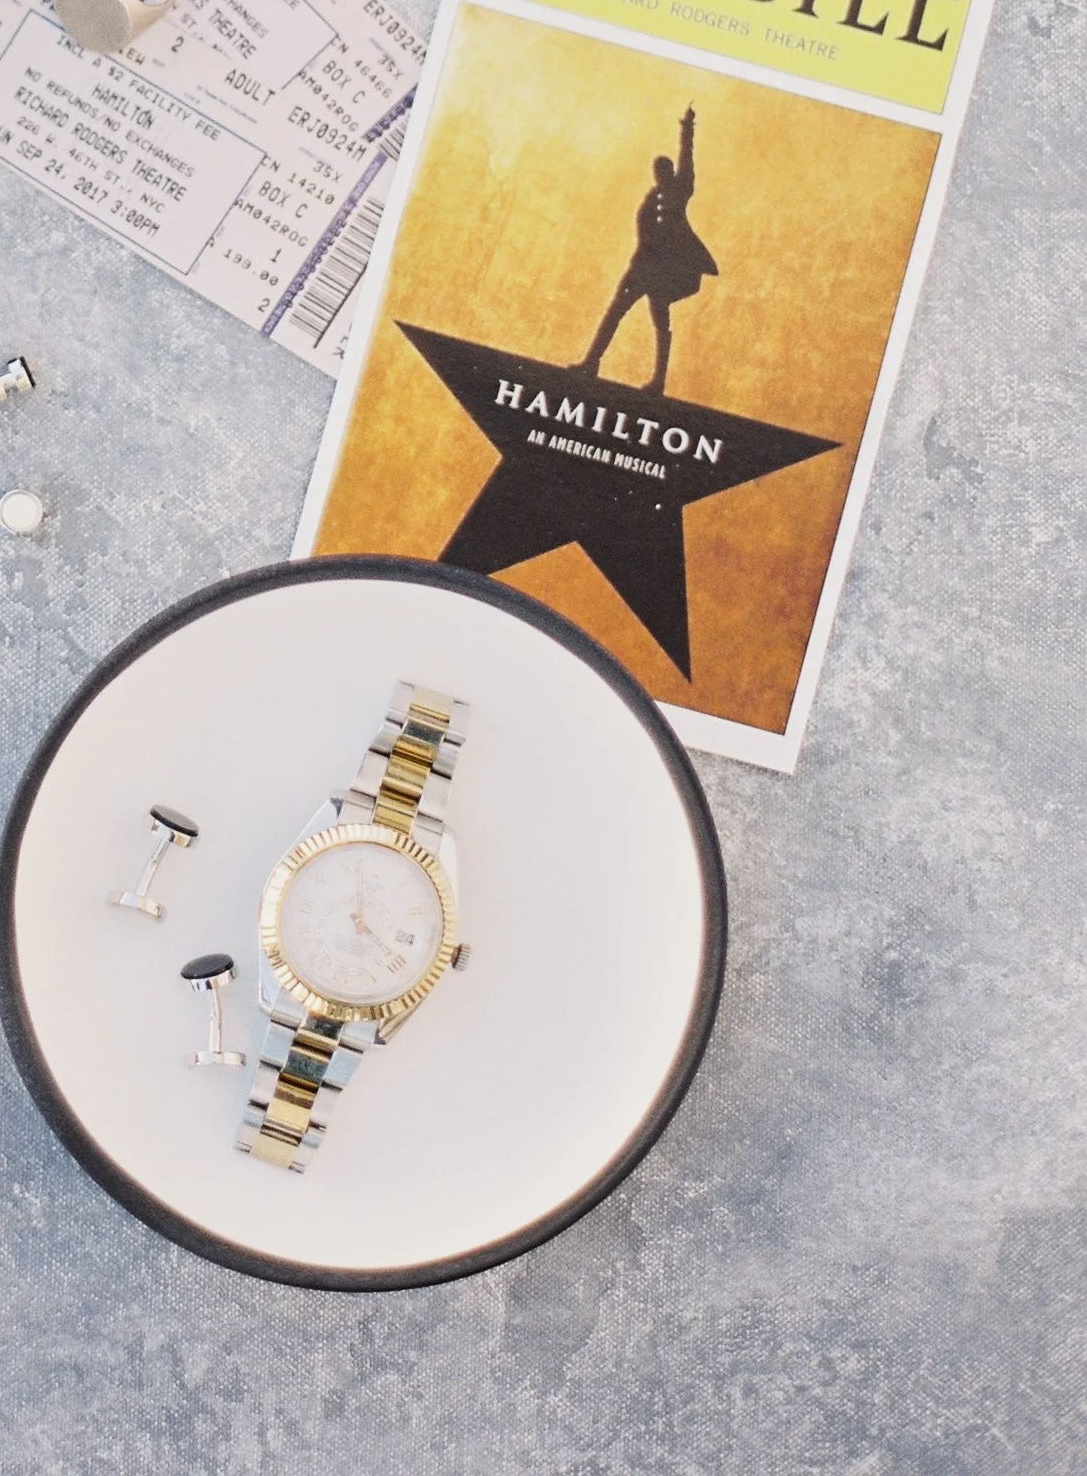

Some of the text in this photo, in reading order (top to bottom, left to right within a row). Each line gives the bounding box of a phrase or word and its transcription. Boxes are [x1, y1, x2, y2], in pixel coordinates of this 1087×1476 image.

[207, 9, 257, 58] THEATRE
[669, 1, 751, 37] RODGERS
[763, 26, 840, 61] THEATRE
[57, 34, 87, 58] INCL
[92, 57, 101, 67] A
[108, 67, 124, 81] $2
[128, 79, 190, 122] FACILITY
[195, 119, 220, 140] FEE
[91, 82, 155, 130] HAMILTON
[171, 36, 184, 52] 2
[224, 67, 274, 107] ADULT
[287, 105, 367, 163] ERJ0924M
[322, 60, 366, 104] BOX C
[13, 86, 186, 201] RICHARD RODGERS THEATRE
[24, 67, 194, 178] NO REFUNDS/NO EXCHANGES
[16, 115, 40, 135] 226
[67, 147, 98, 171] 46TH
[140, 192, 164, 212] NYC
[16, 139, 42, 163] SEP
[74, 176, 107, 204] 2017
[110, 199, 159, 236] 3:00PM
[258, 180, 308, 219] BOX C
[224, 248, 279, 287] 199.00
[270, 248, 282, 262] 1
[257, 297, 271, 313] 2
[494, 379, 723, 464] HAMILTON
[527, 429, 666, 480] AN AMERICAN MUSICAL
